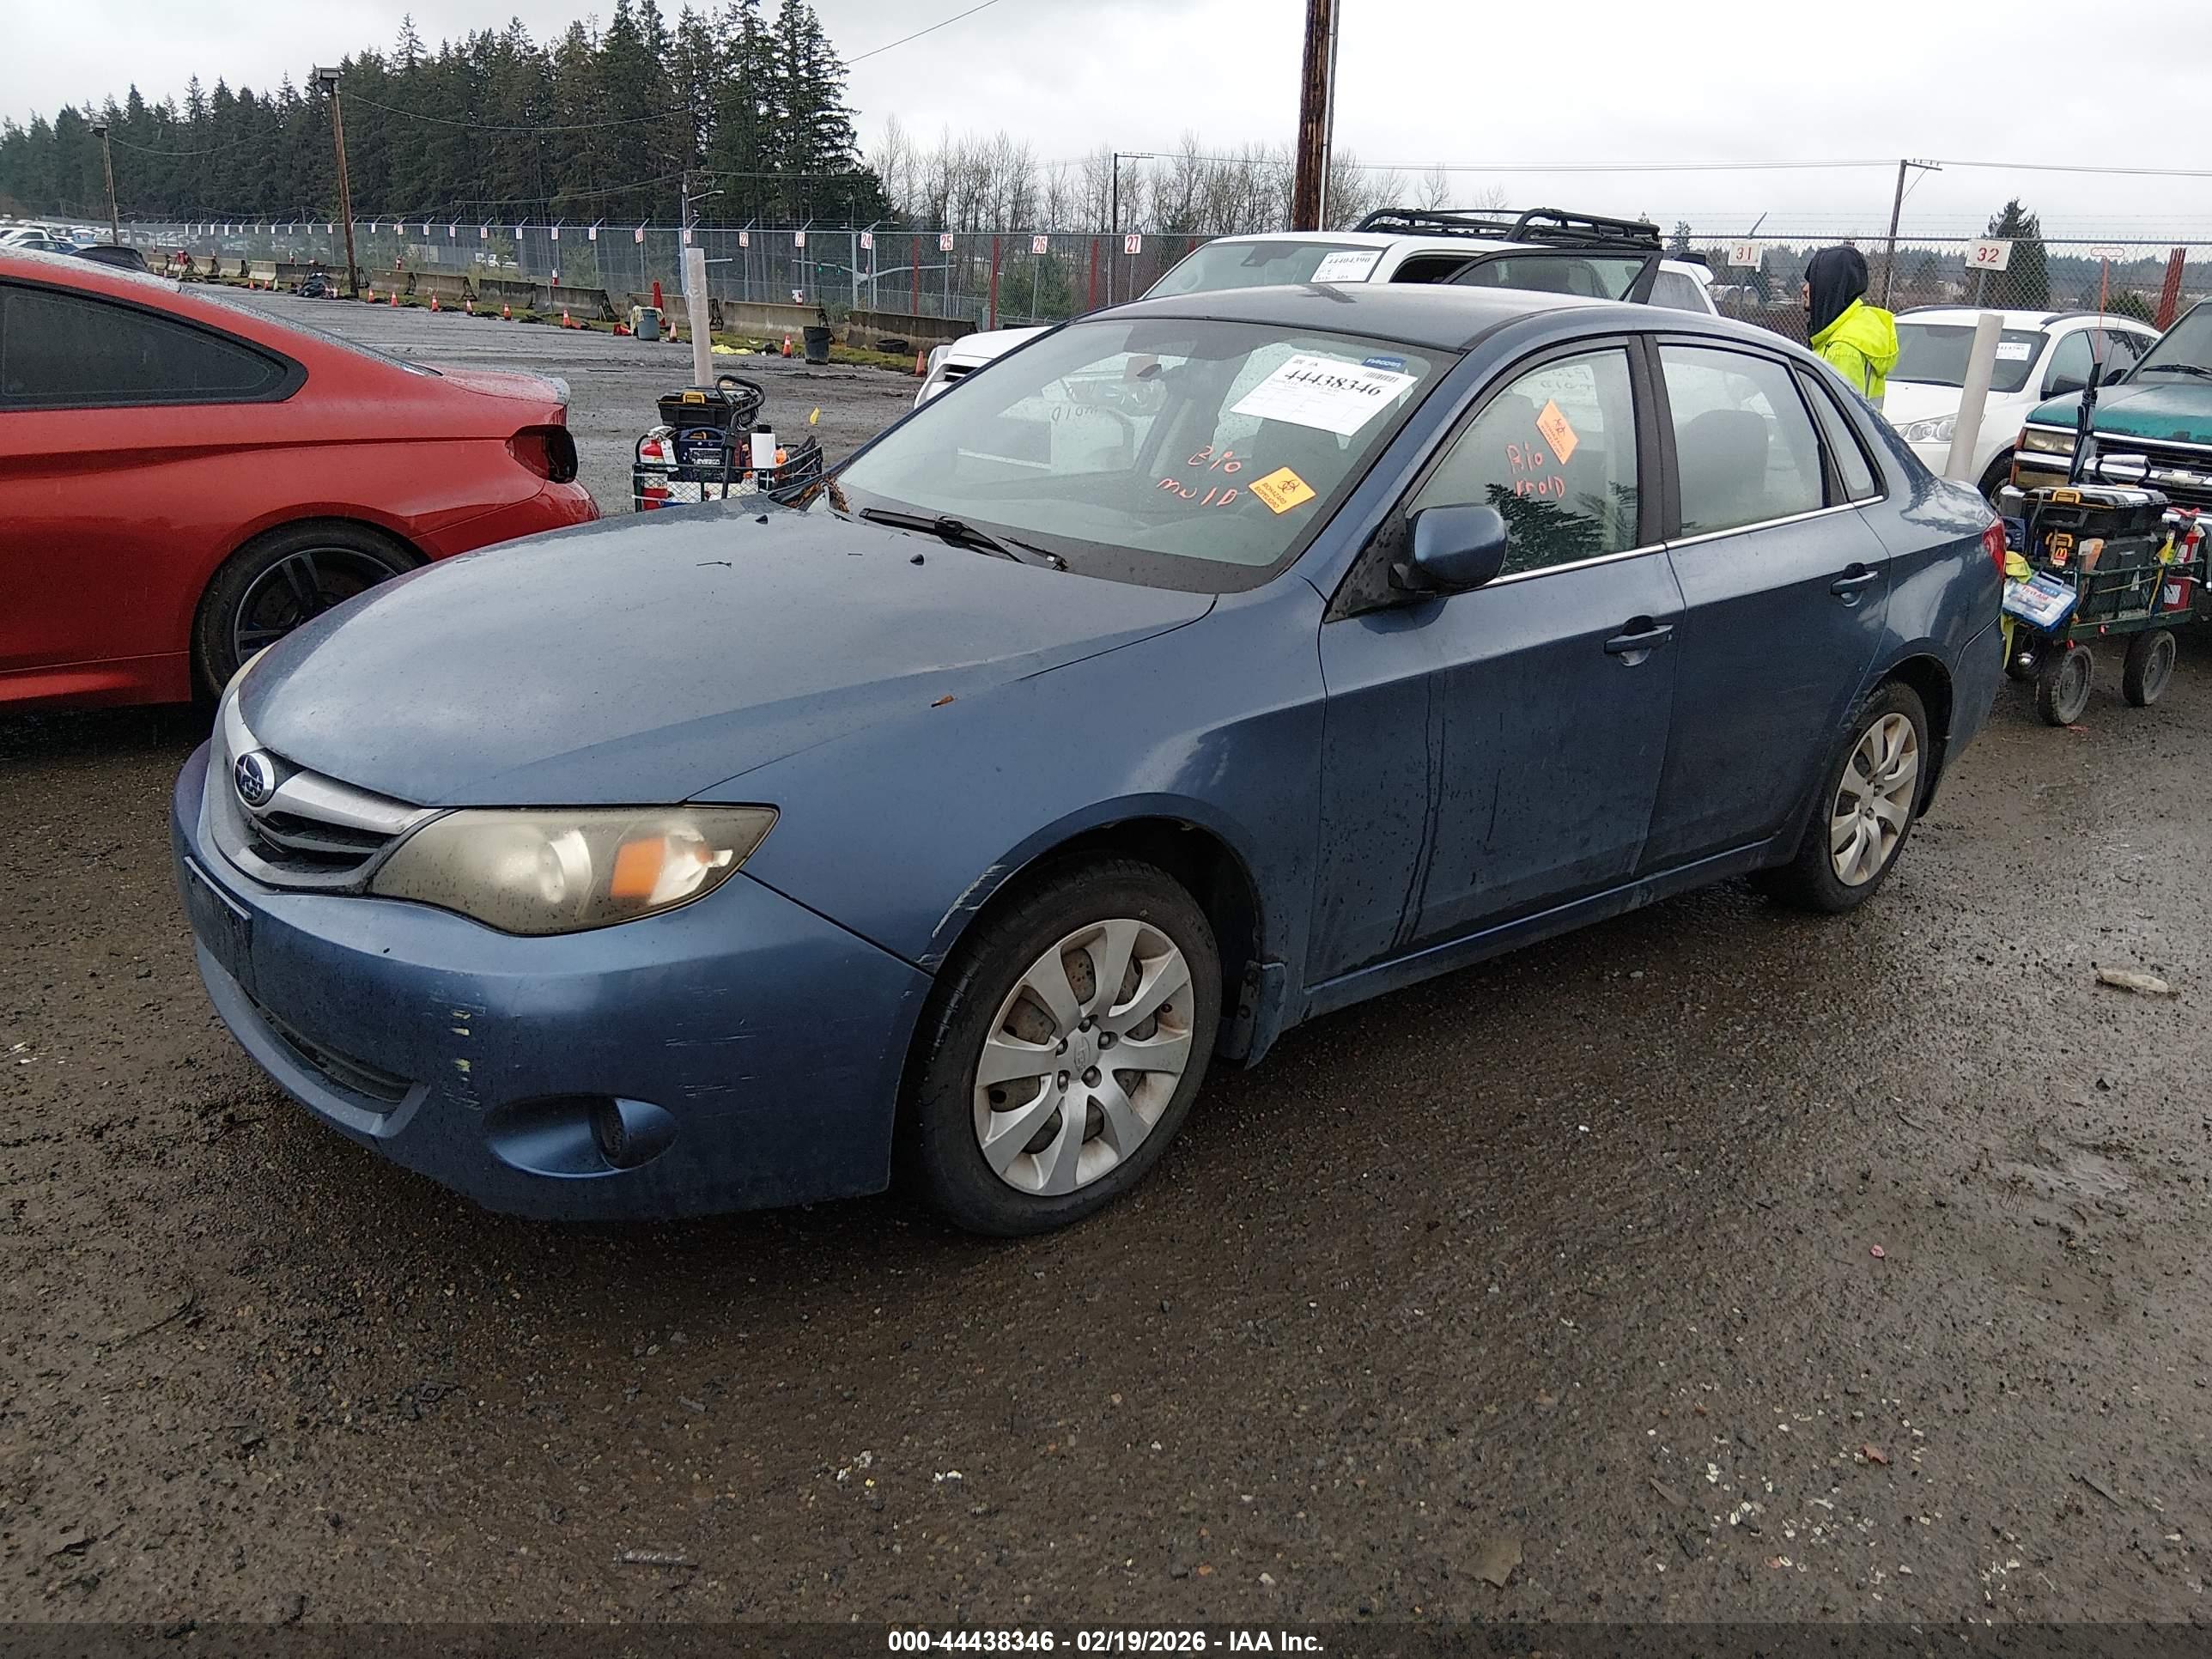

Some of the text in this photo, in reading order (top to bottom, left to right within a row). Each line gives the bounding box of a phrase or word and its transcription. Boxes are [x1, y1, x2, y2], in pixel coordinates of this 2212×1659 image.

[636, 229, 643, 241] 20
[684, 231, 690, 242] 21
[740, 234, 748, 246] 22
[796, 234, 805, 246] 23
[862, 234, 872, 248] 24
[941, 235, 952, 250] 25
[1034, 238, 1047, 252] 26
[1127, 236, 1139, 252] 27
[1735, 246, 1752, 260] 31
[1977, 246, 2000, 263] 32
[1285, 369, 1386, 396] 44438346
